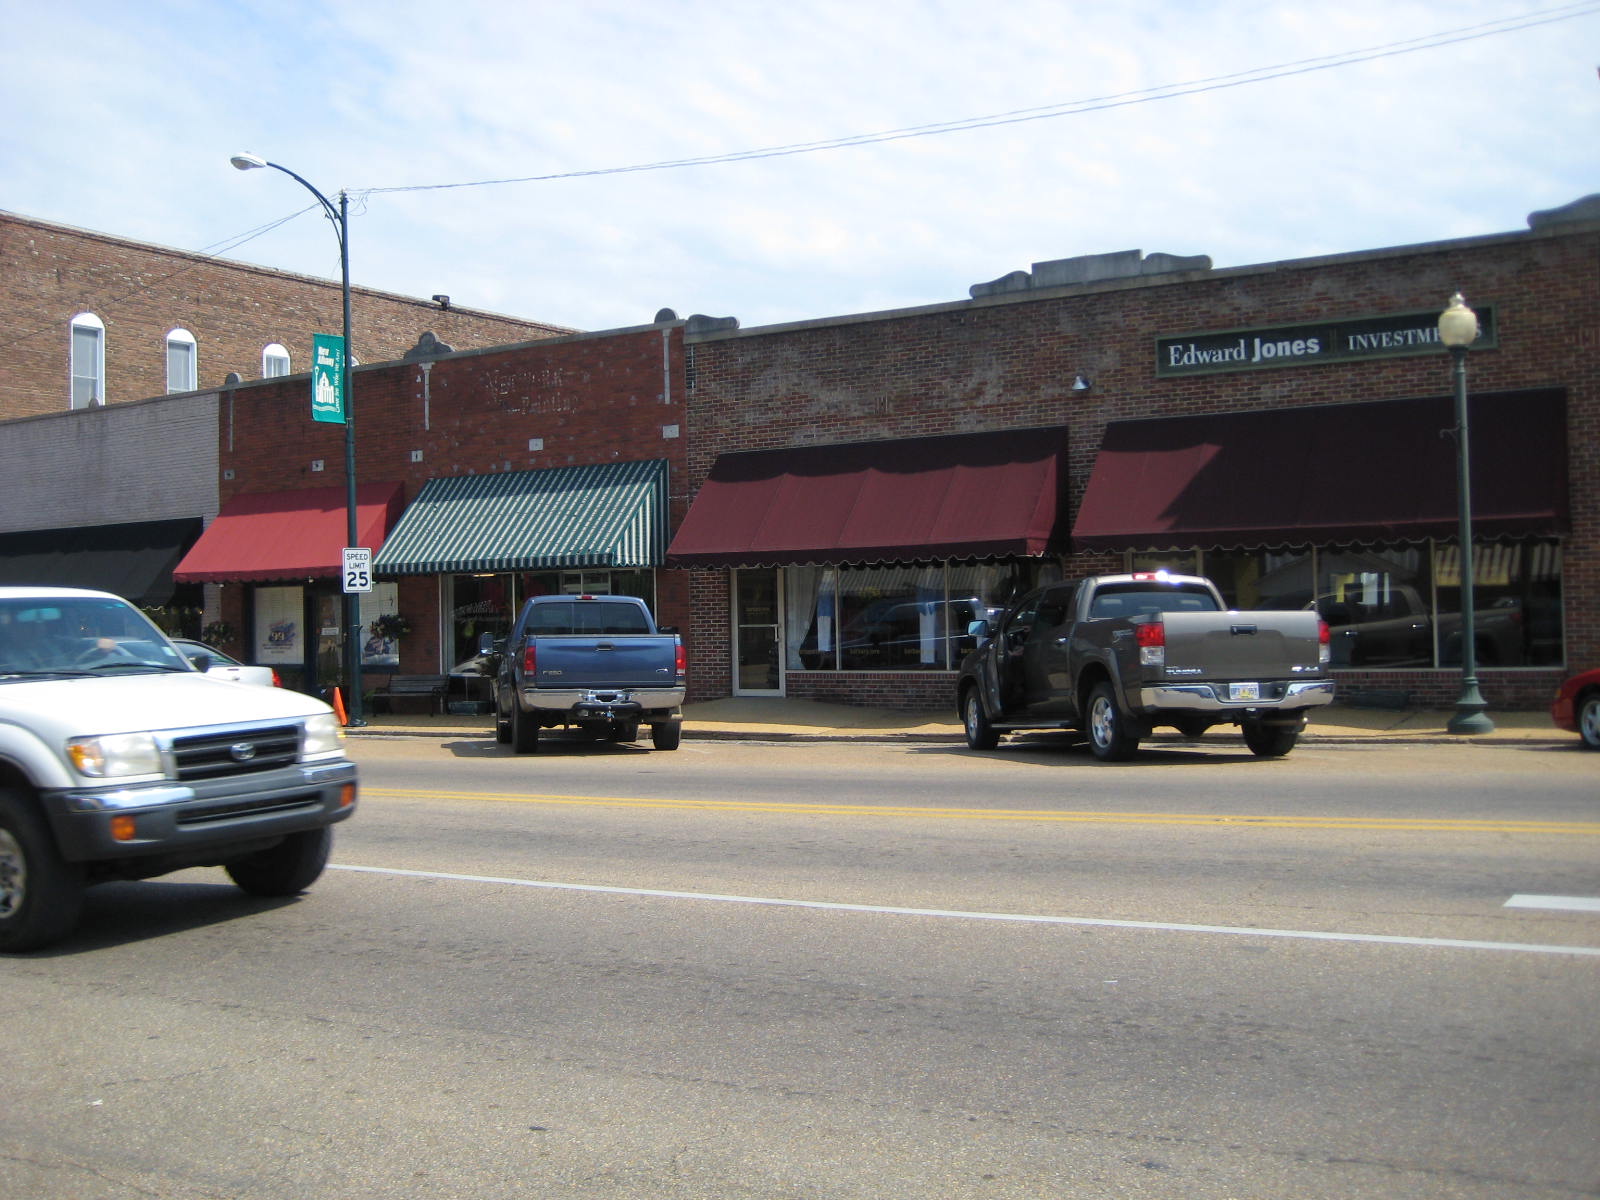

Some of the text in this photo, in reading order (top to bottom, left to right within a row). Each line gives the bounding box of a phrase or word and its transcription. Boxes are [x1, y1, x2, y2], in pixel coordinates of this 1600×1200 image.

[1168, 322, 1482, 367] Edward Jones INVESTMES
[347, 571, 368, 587] 25
